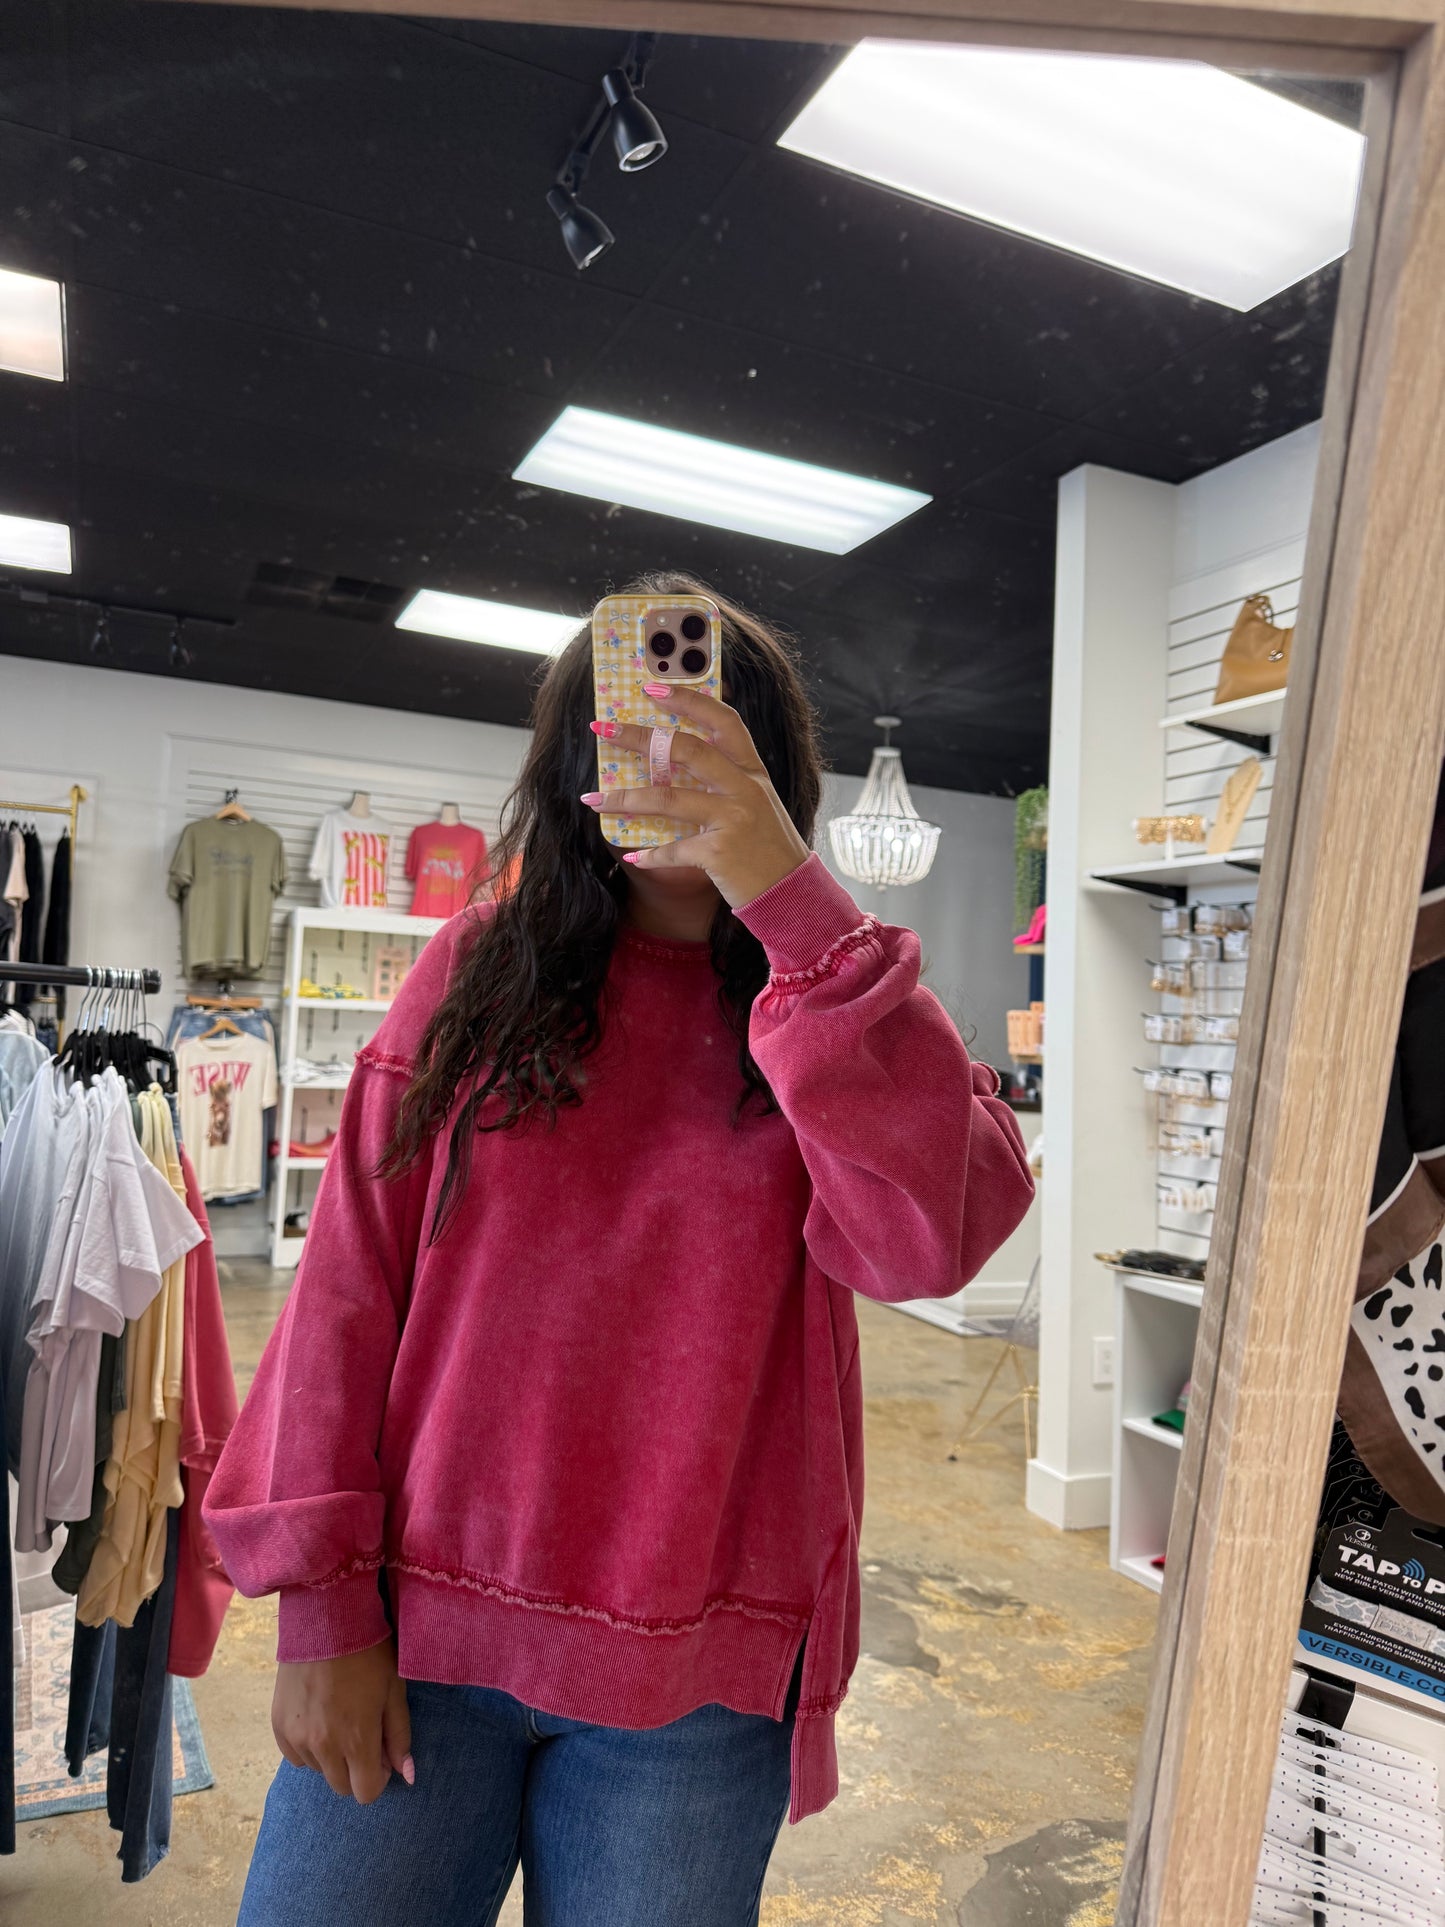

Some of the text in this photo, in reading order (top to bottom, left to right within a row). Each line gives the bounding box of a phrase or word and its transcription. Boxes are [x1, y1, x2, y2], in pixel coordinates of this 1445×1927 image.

[1338, 1544, 1401, 1576] TAP
[1402, 1575, 1422, 1589] TO
[1340, 1567, 1356, 1576] TAP
[1356, 1572, 1373, 1582] THE
[1373, 1579, 1400, 1592] PATCH
[1400, 1588, 1423, 1601] WITH
[1334, 1571, 1354, 1582] NEW
[1354, 1578, 1377, 1591] BIBLE
[1378, 1586, 1405, 1601] VERSE
[1405, 1597, 1424, 1608] AND
[1324, 1623, 1374, 1646] TRAFFICKING
[1375, 1643, 1393, 1653] AND
[1393, 1650, 1437, 1671] SUPPORTS
[1333, 1622, 1359, 1634] EVERY
[1359, 1630, 1404, 1651] PURCHASE
[1404, 1648, 1433, 1663] FIGHTS
[1308, 1637, 1445, 1697] VERSIBLE.CO
